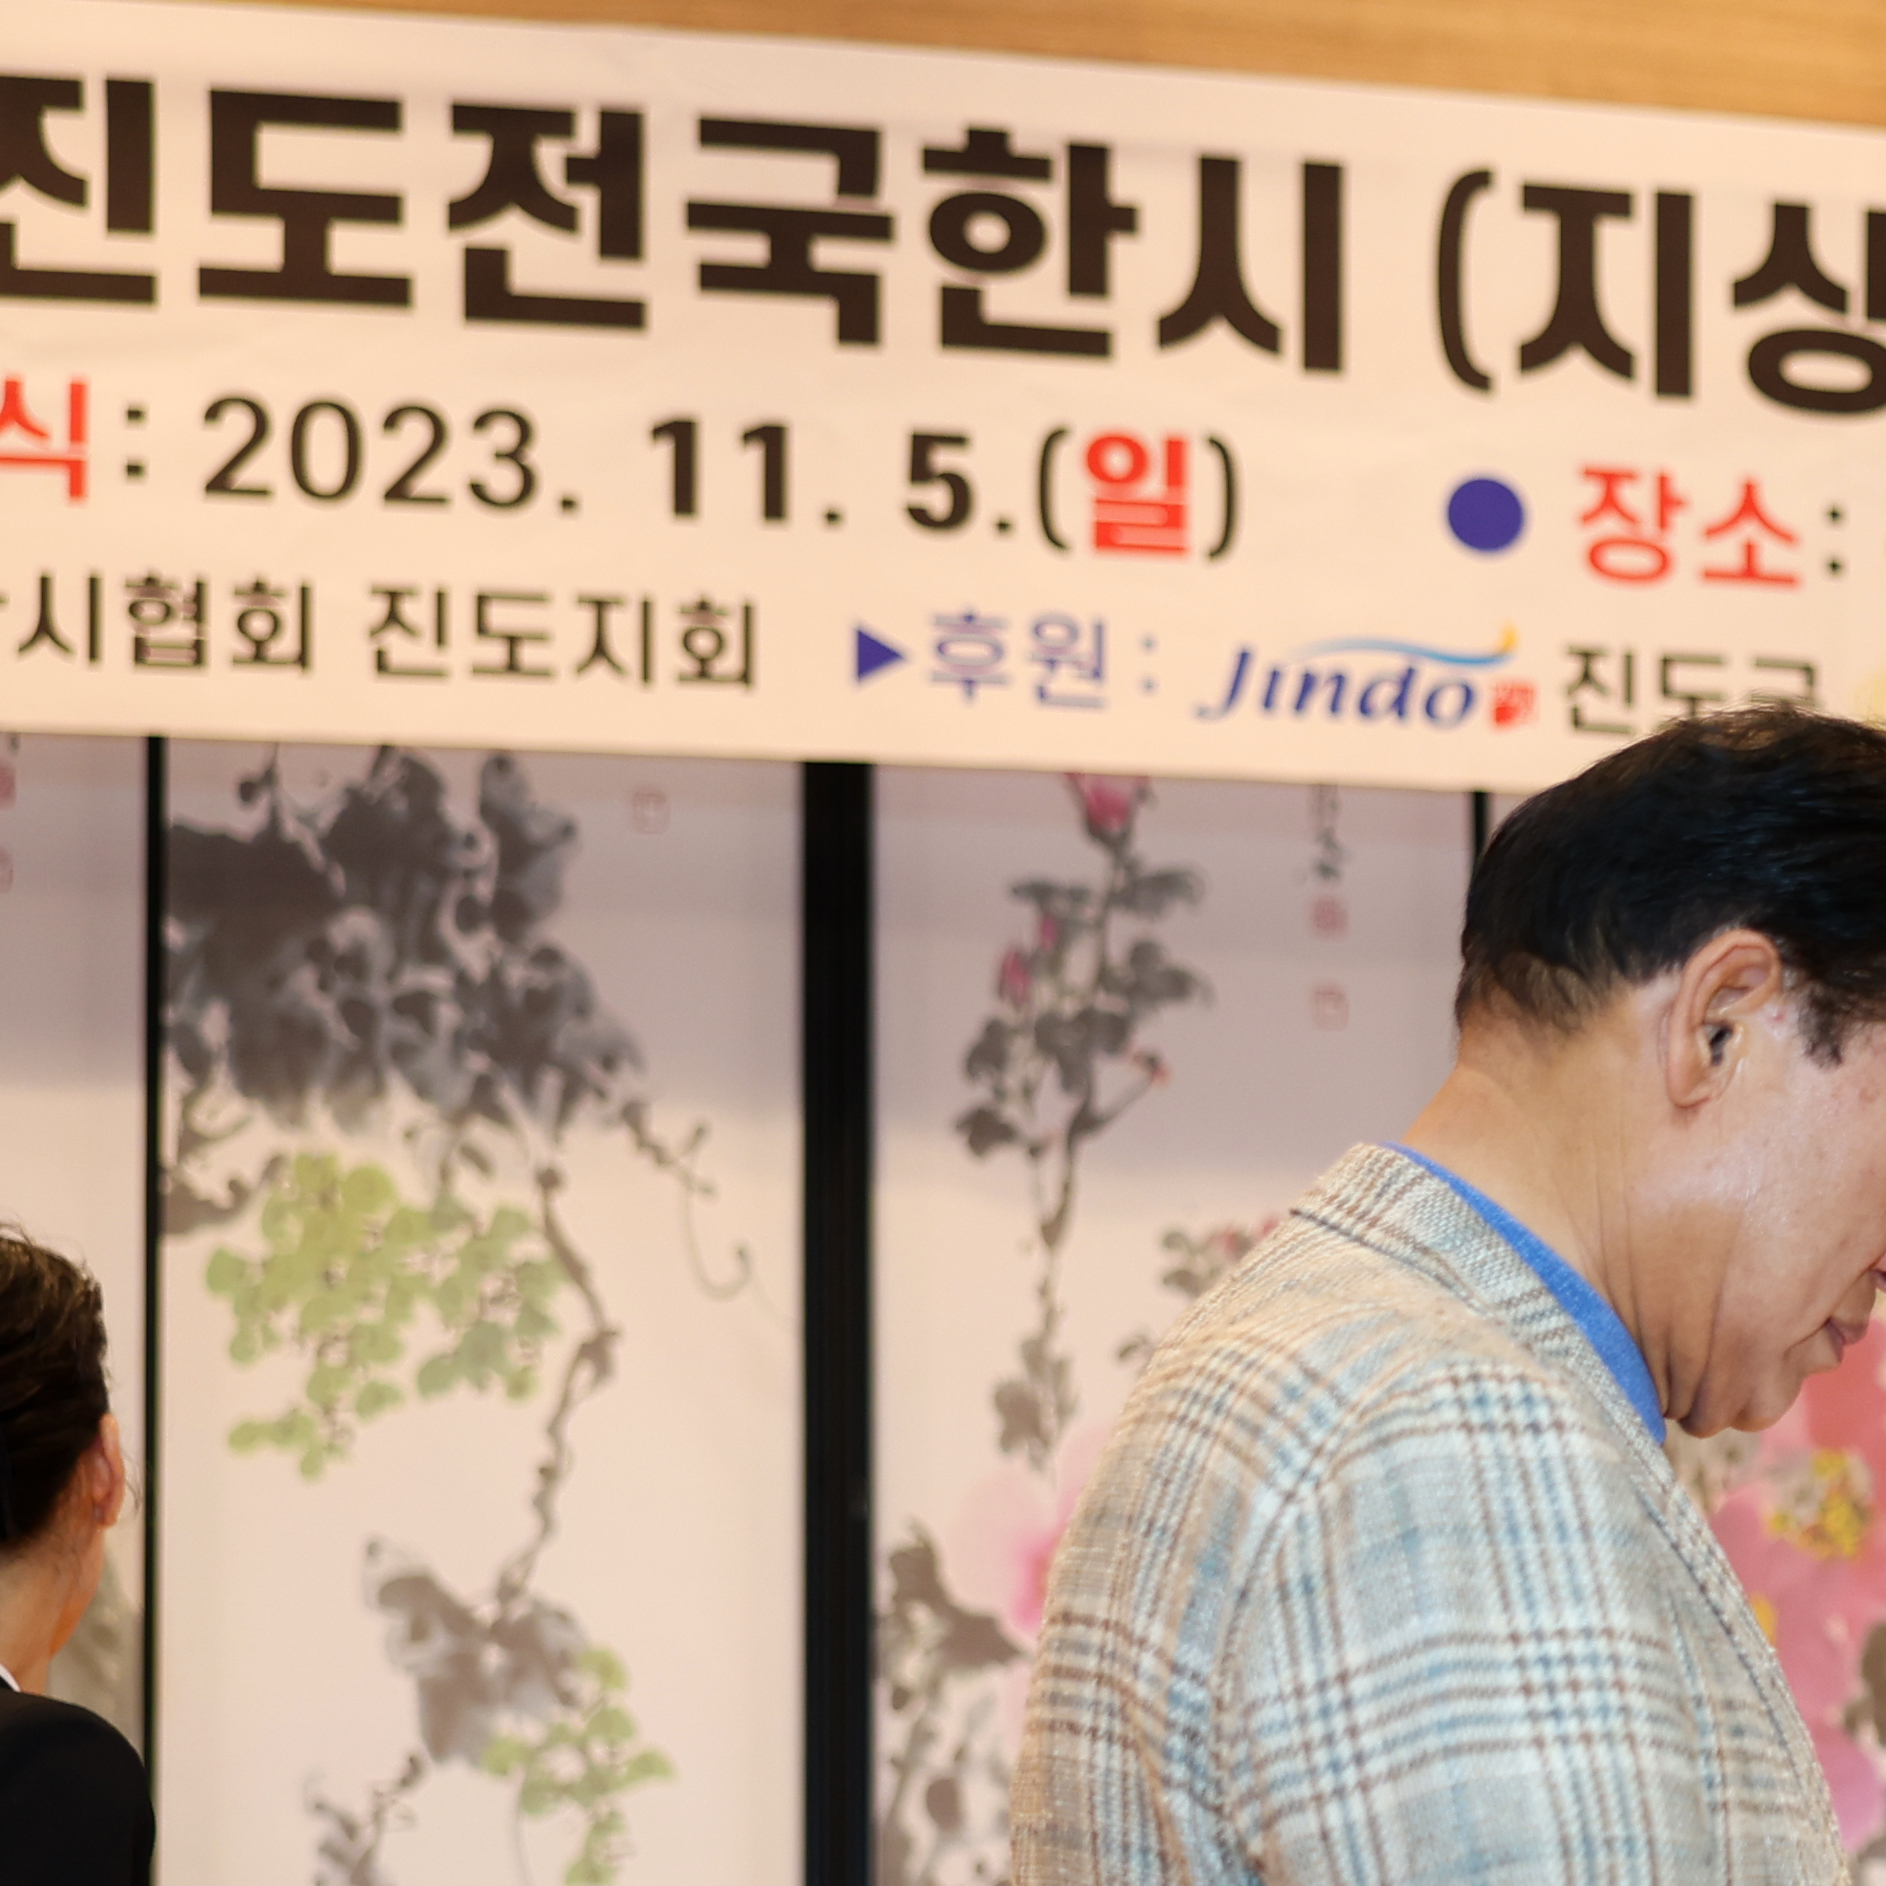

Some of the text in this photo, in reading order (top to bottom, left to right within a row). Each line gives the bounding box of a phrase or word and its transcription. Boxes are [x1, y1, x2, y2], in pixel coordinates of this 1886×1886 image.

[203, 394, 578, 513] 2023.
[649, 416, 843, 526] 11.
[1578, 464, 1846, 589] 장소:
[0, 573, 755, 689] 시협회 진도지회
[1199, 649, 1477, 724] Jindo
